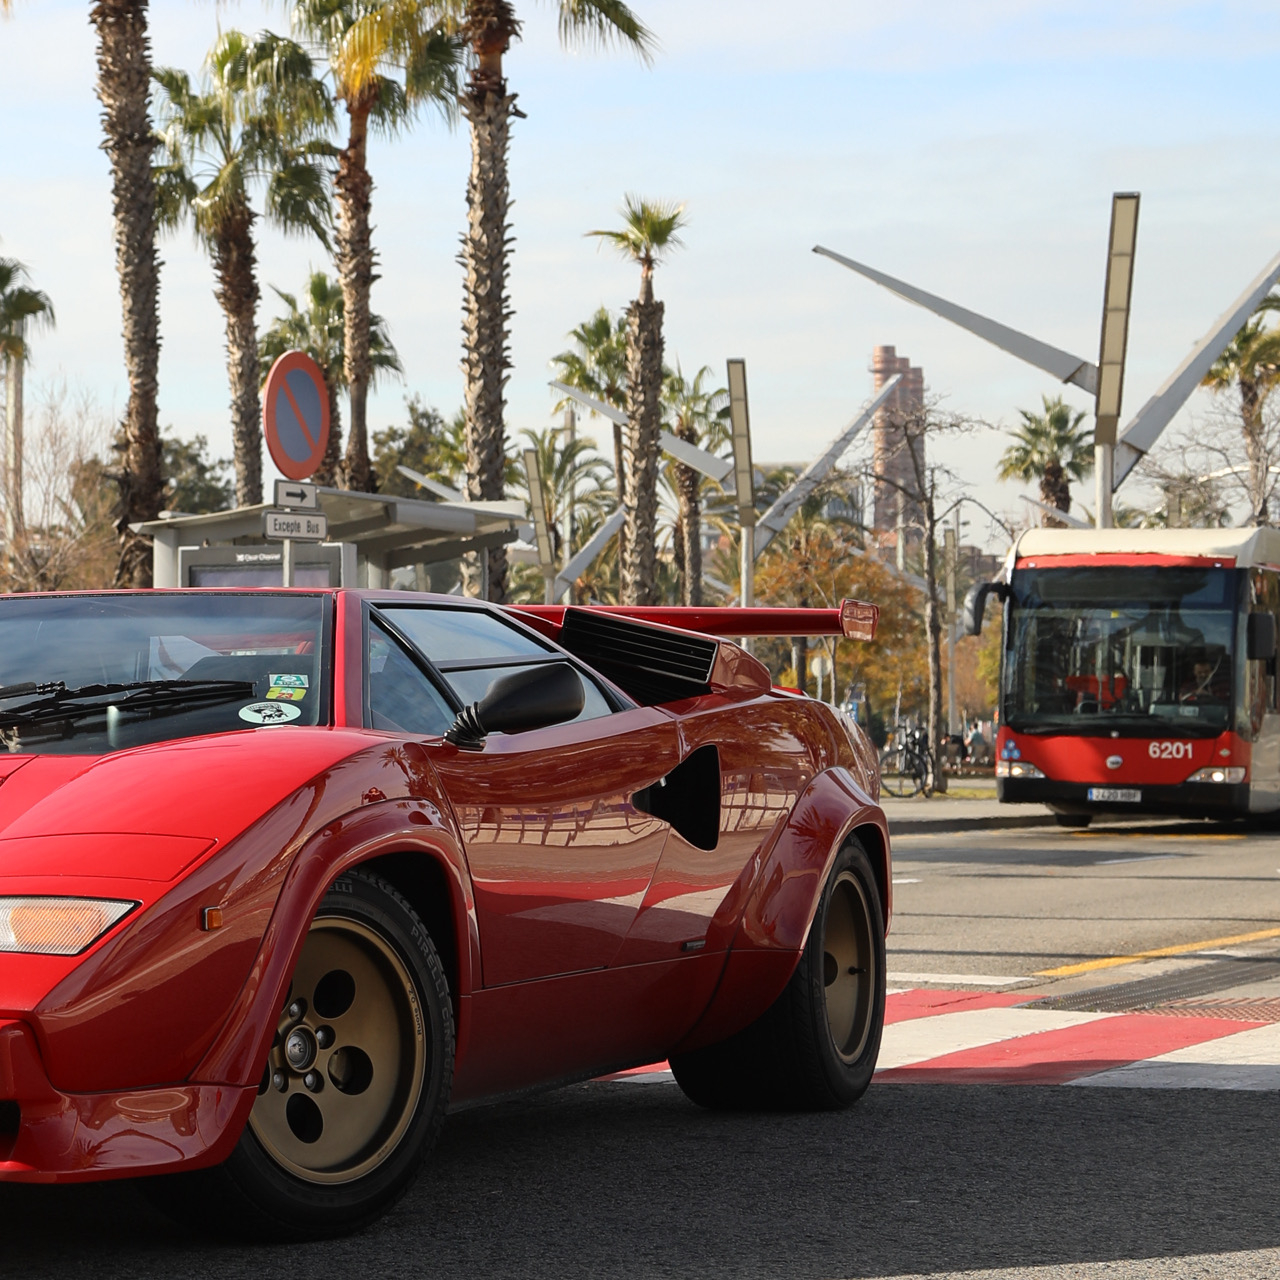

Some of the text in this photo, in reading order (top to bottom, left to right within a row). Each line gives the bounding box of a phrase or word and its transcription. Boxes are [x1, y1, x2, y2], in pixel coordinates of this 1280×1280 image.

[306, 520, 320, 534] Bus
[1148, 741, 1193, 759] 6201
[410, 925, 445, 999] PIRELLI
